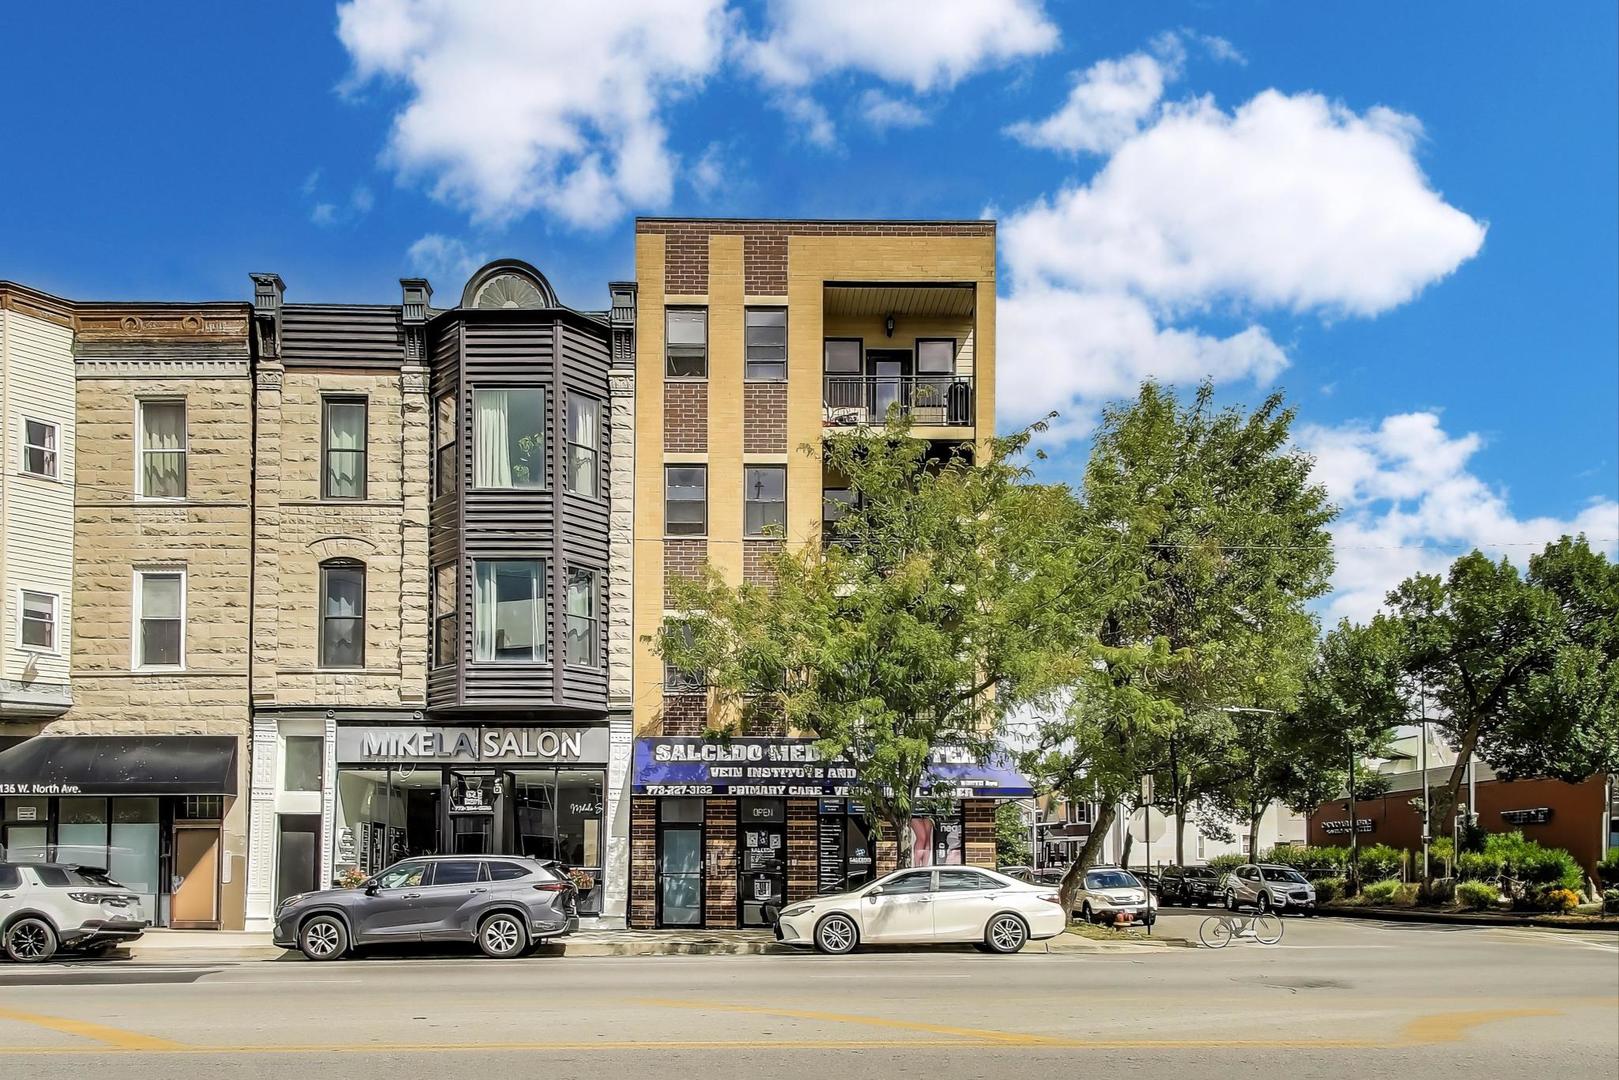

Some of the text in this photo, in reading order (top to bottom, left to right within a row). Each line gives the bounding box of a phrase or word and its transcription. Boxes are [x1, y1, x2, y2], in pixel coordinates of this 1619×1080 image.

[361, 731, 582, 758] MIKELA SALON
[656, 744, 762, 762] SALCEDO
[710, 767, 857, 778] VEIN INSTITUTE AND
[17, 784, 30, 793] W.
[32, 784, 60, 793] North
[61, 784, 82, 793] Ave.
[728, 786, 785, 795] PRIMARY
[788, 786, 823, 796] CARE
[752, 807, 774, 817] OPEN
